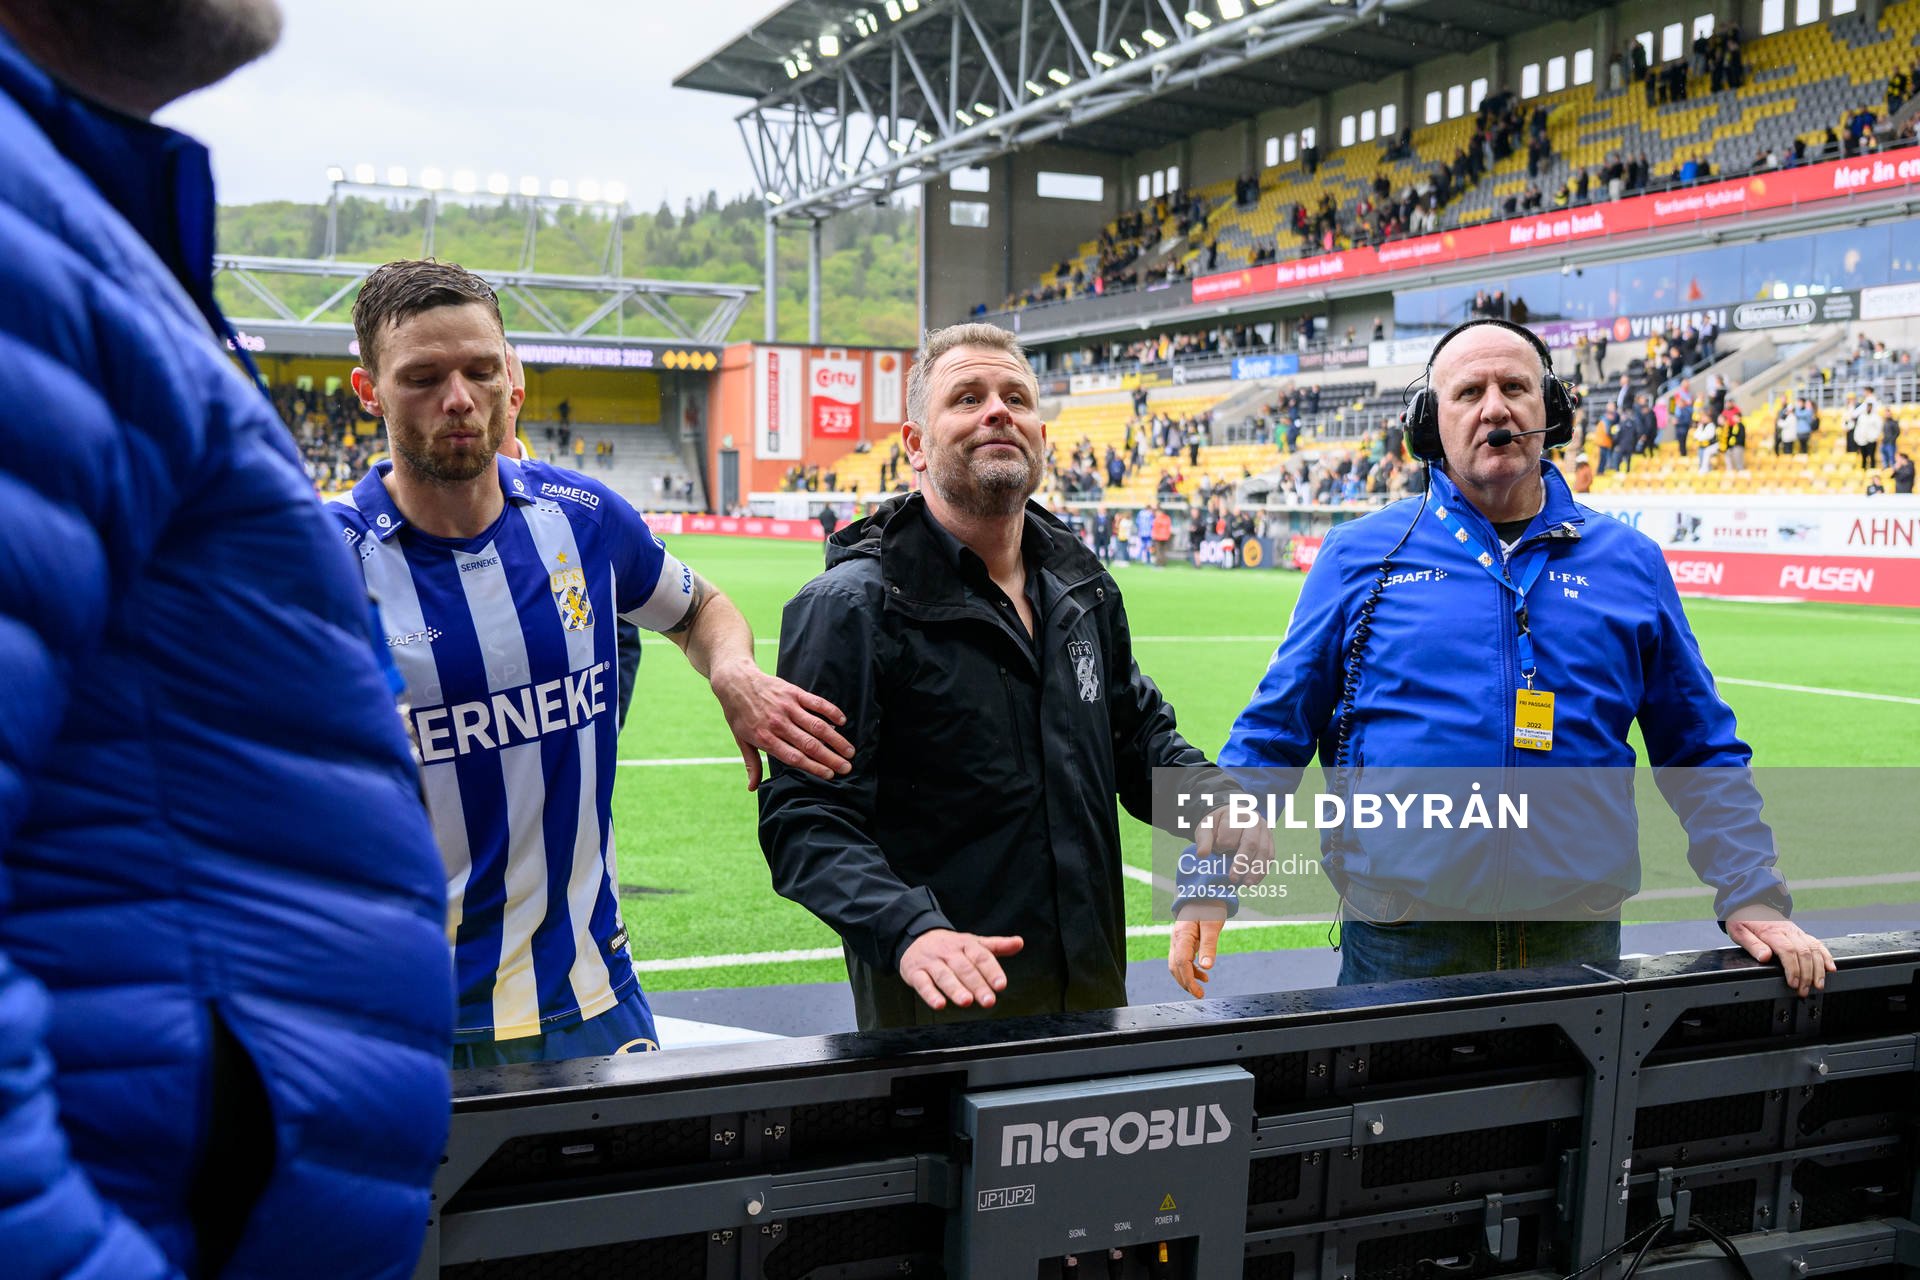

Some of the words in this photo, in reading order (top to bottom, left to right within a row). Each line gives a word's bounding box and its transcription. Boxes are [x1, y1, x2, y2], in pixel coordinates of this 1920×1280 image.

[1833, 166, 1870, 190] Mer
[1872, 160, 1895, 183] än
[541, 482, 600, 507] FAMECO
[1847, 518, 1920, 547] AHN
[461, 556, 498, 573] SERNEKE
[1779, 565, 1875, 593] PULSEN
[1563, 587, 1579, 599] Per
[384, 631, 425, 647] RAFT
[415, 662, 607, 763] ERNEKE
[1527, 721, 1542, 729] 2022
[980, 1190, 1005, 1208] JP1
[1007, 1187, 1033, 1205] JP2
[1114, 1221, 1132, 1232] SIGNAL
[1154, 1214, 1173, 1226] POWER
[1174, 1213, 1180, 1223] IN
[1068, 1227, 1087, 1239] SIGNAL
